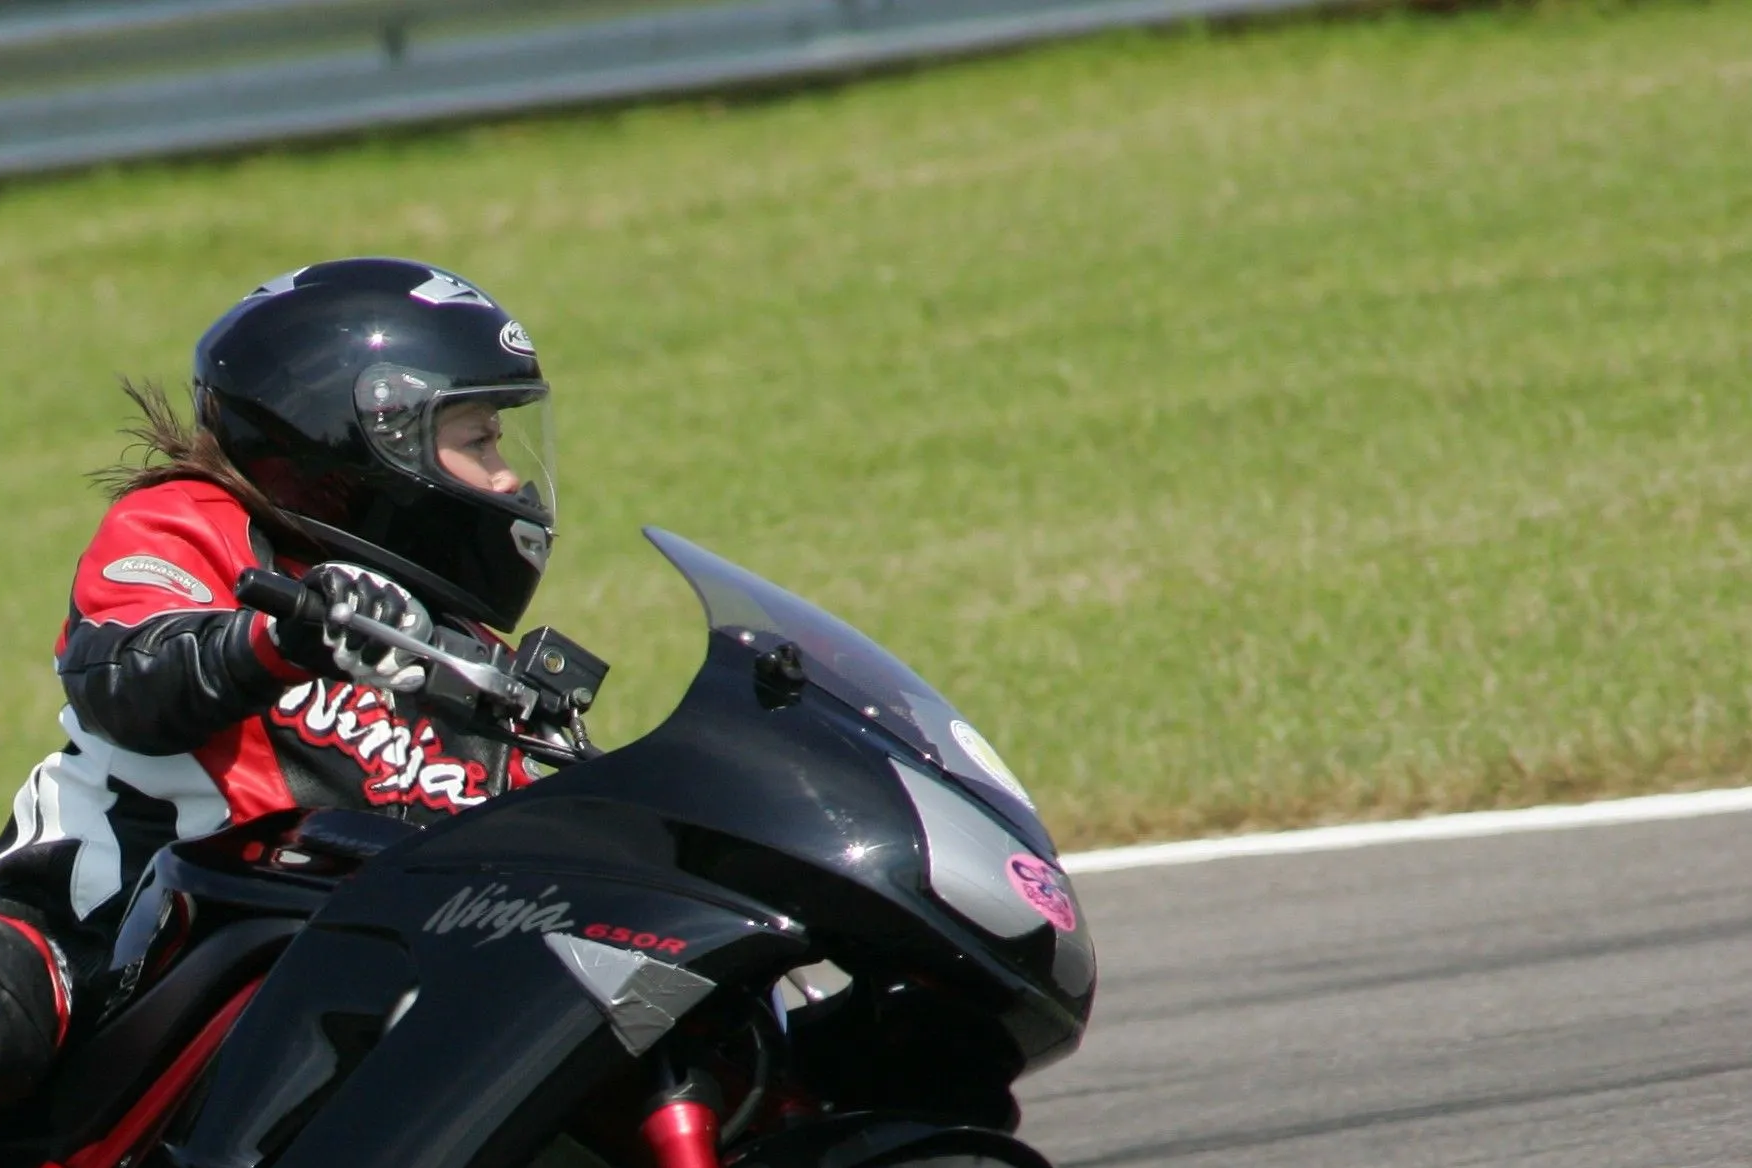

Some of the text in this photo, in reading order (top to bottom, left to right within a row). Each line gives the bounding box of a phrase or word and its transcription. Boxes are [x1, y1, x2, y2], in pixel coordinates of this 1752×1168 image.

[120, 559, 199, 590] Kawasaki
[276, 678, 488, 807] Ninja
[422, 882, 688, 956] Ninja 650R
